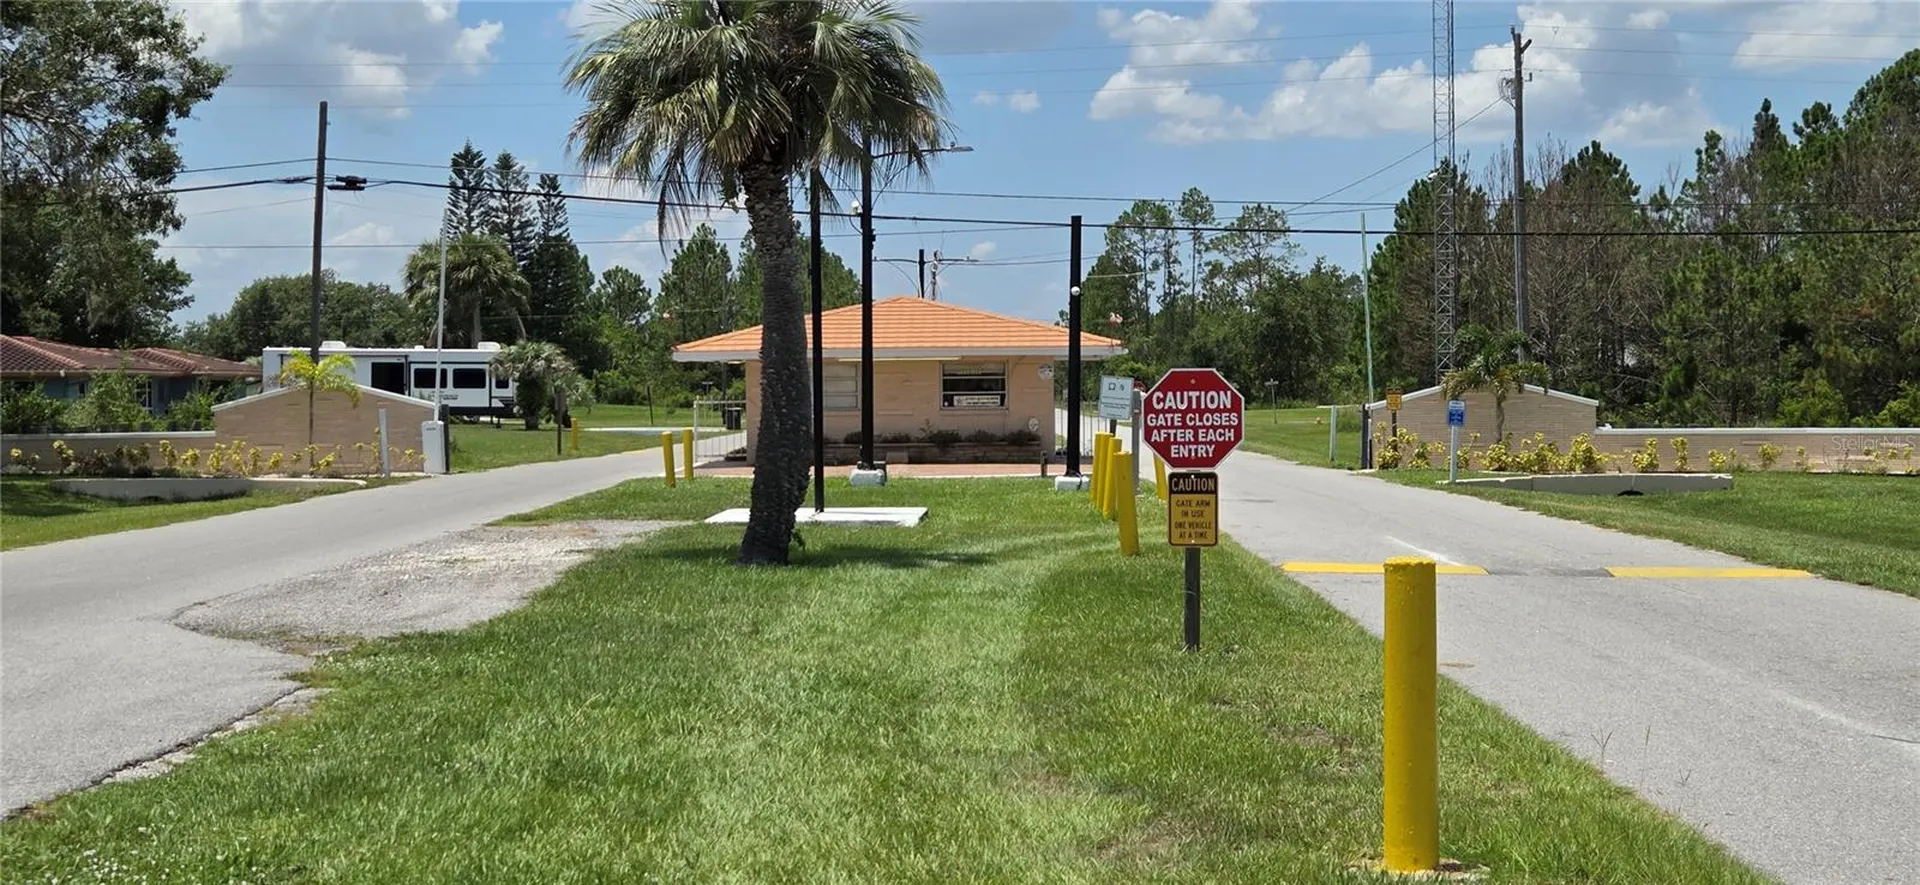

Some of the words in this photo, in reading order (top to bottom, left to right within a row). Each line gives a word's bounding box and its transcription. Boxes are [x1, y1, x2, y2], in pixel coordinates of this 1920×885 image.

[1152, 390, 1231, 410] CAUTION
[1147, 413, 1182, 426] GATE
[1186, 412, 1239, 426] CLOSES
[1151, 428, 1194, 442] AFTER
[1198, 428, 1234, 442] EACH
[1170, 444, 1215, 458] ENTRY
[1171, 477, 1215, 491] CAUTION
[1175, 500, 1193, 508] GATE
[1195, 499, 1211, 507] ARM
[1181, 510, 1189, 518] IN
[1191, 510, 1204, 518] USE
[1174, 521, 1187, 529] ONE
[1188, 521, 1212, 530] VEHICLE
[1179, 531, 1187, 539] AT
[1194, 531, 1209, 539] TIME
